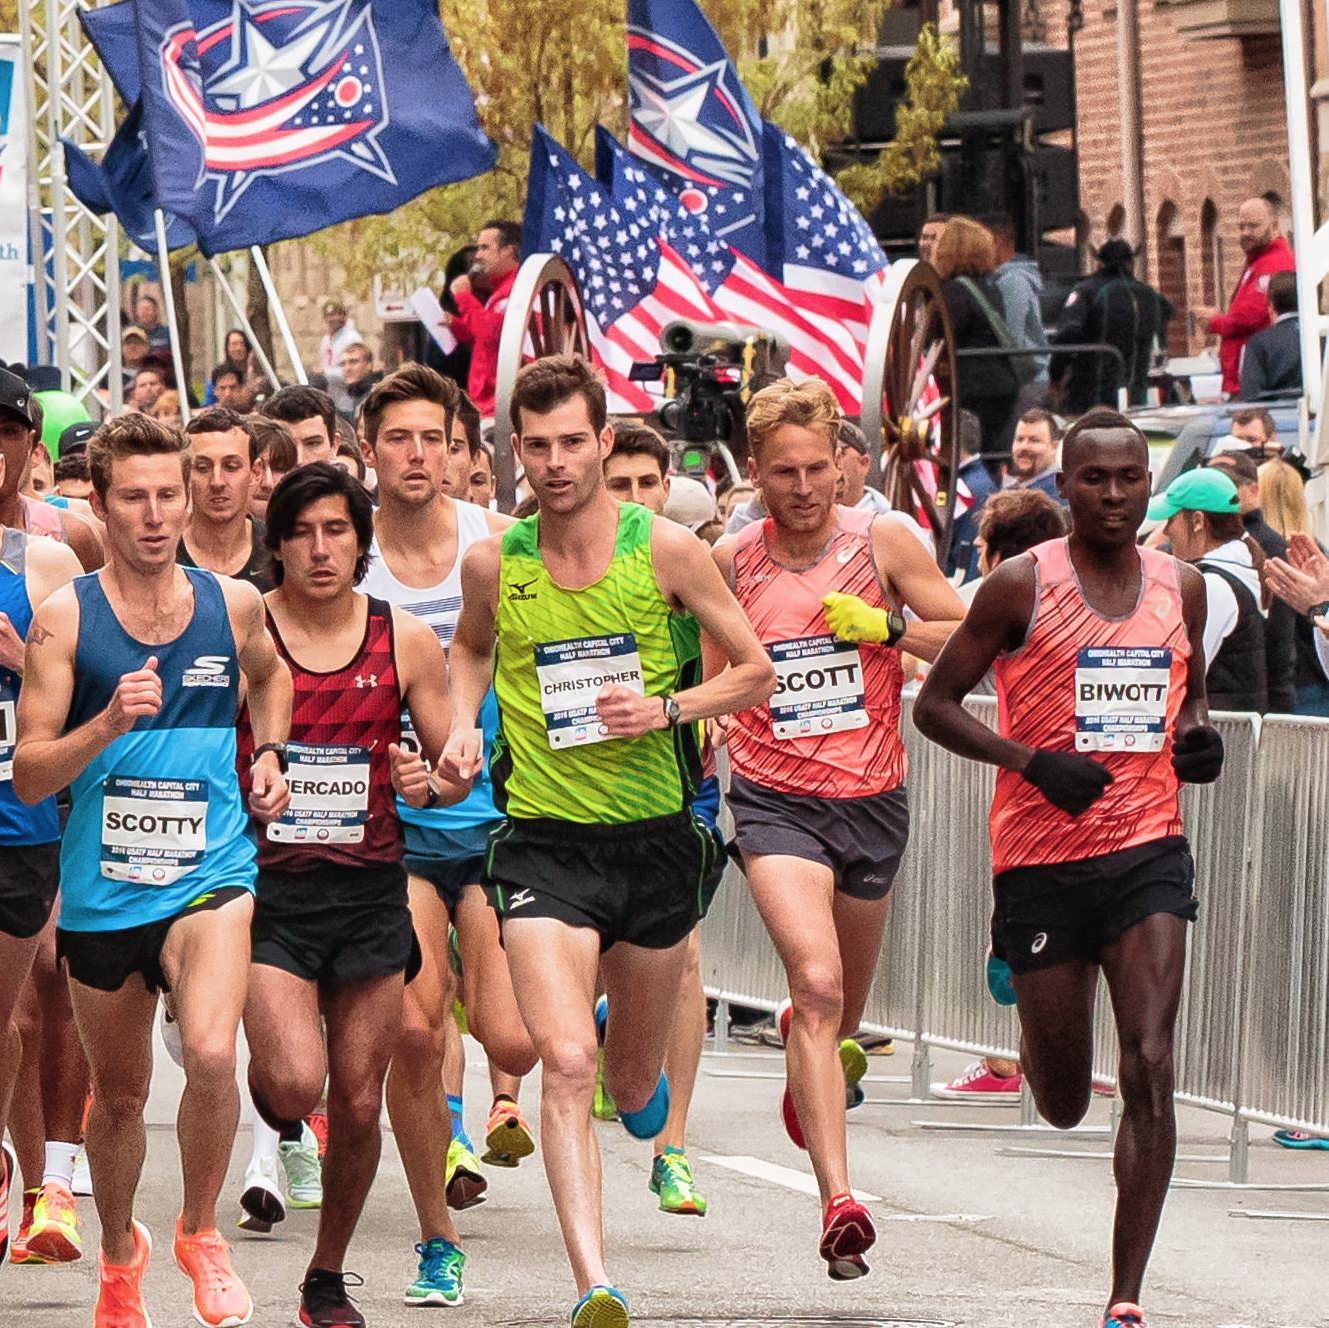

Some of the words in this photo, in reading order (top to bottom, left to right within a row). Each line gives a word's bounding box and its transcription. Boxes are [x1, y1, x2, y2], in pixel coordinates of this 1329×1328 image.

[583, 639, 609, 649] CAPITAL
[610, 636, 624, 646] CITY
[808, 637, 833, 647] CAPITAL
[544, 670, 640, 695] CHRISTOPHER
[774, 663, 858, 694] SCOTT
[1080, 684, 1167, 701] BIWOTT
[158, 782, 184, 790] CAPITAL
[185, 783, 200, 791] CITY
[106, 812, 203, 834] SCOTTY
